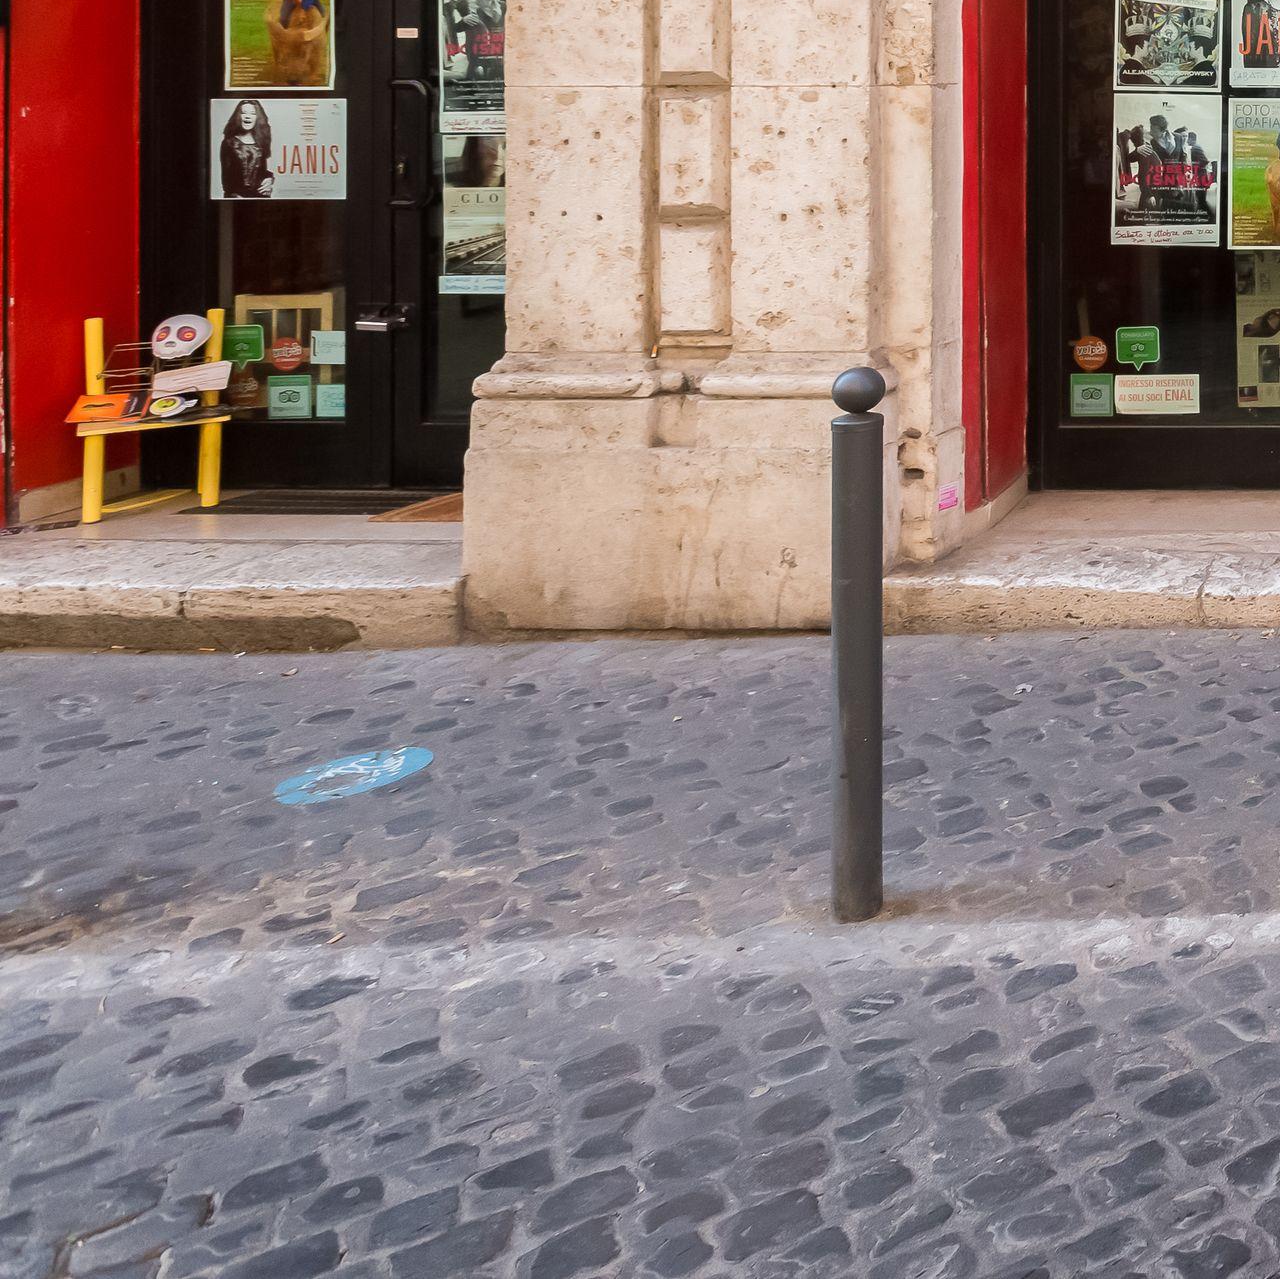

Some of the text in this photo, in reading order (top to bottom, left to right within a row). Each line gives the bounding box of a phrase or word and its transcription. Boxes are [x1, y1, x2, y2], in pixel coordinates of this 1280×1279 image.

[1235, 104, 1271, 117] FOTO
[1234, 117, 1280, 129] GRAFIA
[277, 144, 339, 174] JANIS
[1155, 378, 1195, 387] RISERVATO
[1127, 394, 1144, 402] SOLI
[1146, 394, 1162, 402] SOCI
[1164, 389, 1195, 401] ENAL
